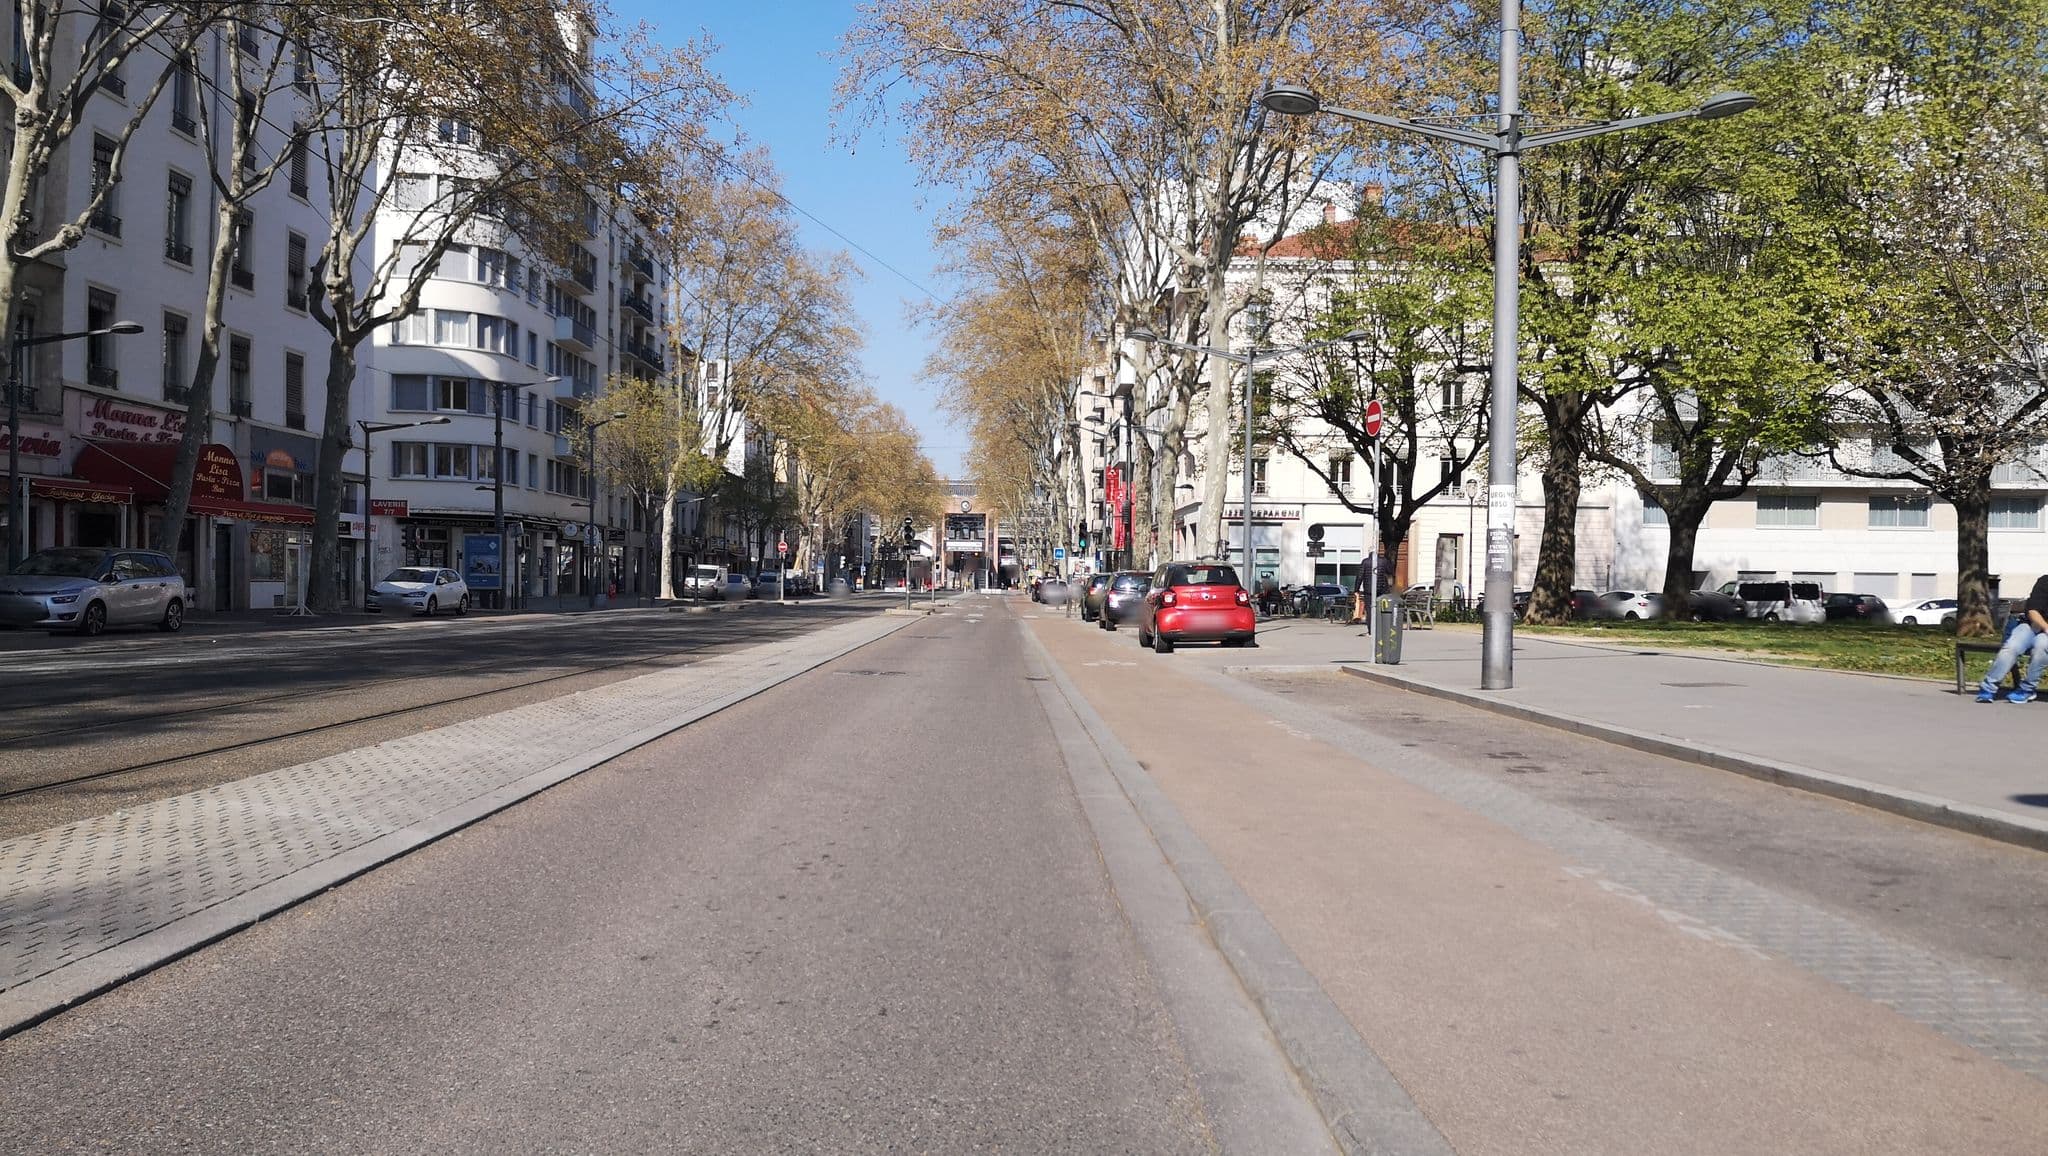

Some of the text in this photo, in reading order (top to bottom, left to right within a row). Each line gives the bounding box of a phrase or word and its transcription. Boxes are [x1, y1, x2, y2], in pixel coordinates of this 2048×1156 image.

[86, 399, 186, 433] Monna Lis
[92, 421, 138, 440] Pasta
[203, 451, 235, 465] Monna
[209, 464, 229, 476] Lisa
[196, 473, 216, 483] Pasta
[221, 476, 241, 488] Pizza
[372, 500, 406, 508] LAVERIE
